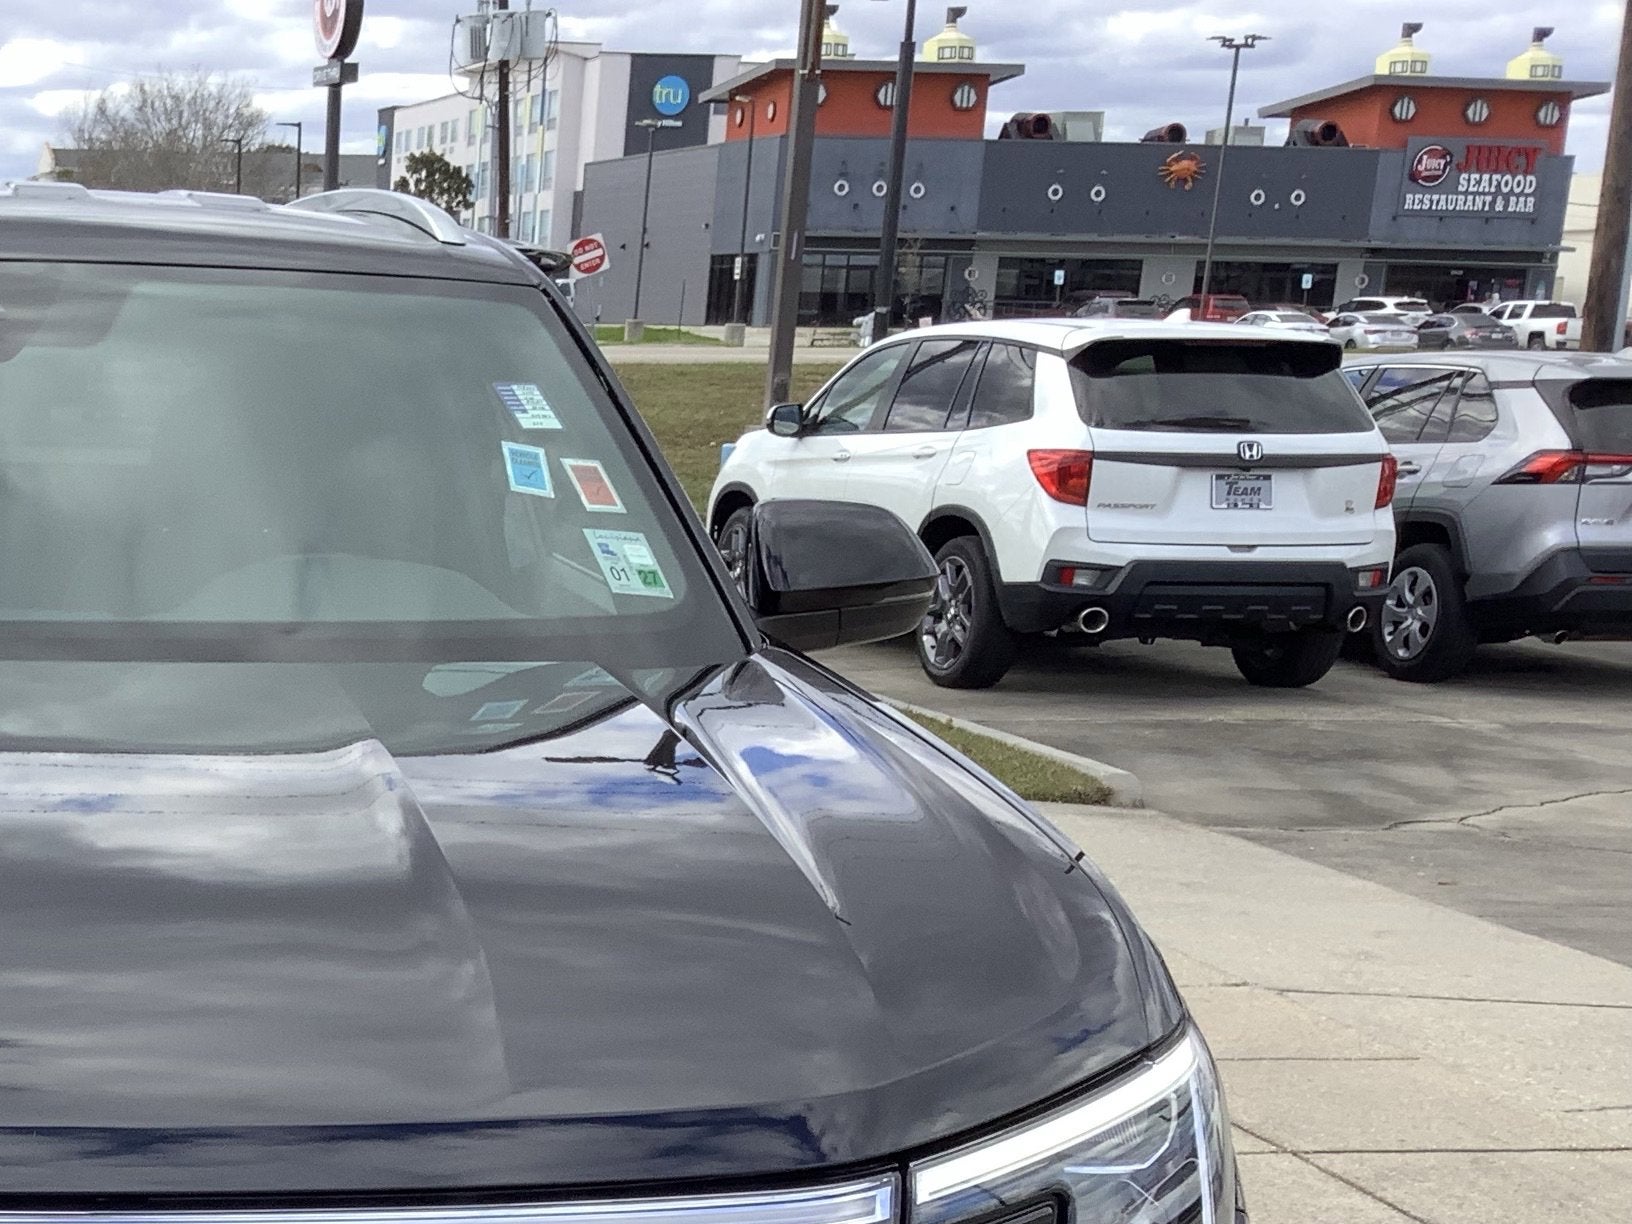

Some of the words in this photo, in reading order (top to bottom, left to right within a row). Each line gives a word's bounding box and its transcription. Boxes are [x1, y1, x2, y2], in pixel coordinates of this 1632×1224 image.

[655, 84, 682, 104] tru
[1455, 144, 1541, 174] JUICY
[1457, 173, 1537, 194] SEAFOOD
[1404, 193, 1492, 212] RESTAURANT
[1494, 195, 1506, 212] &
[1507, 196, 1536, 213] BAR
[609, 566, 631, 582] 01
